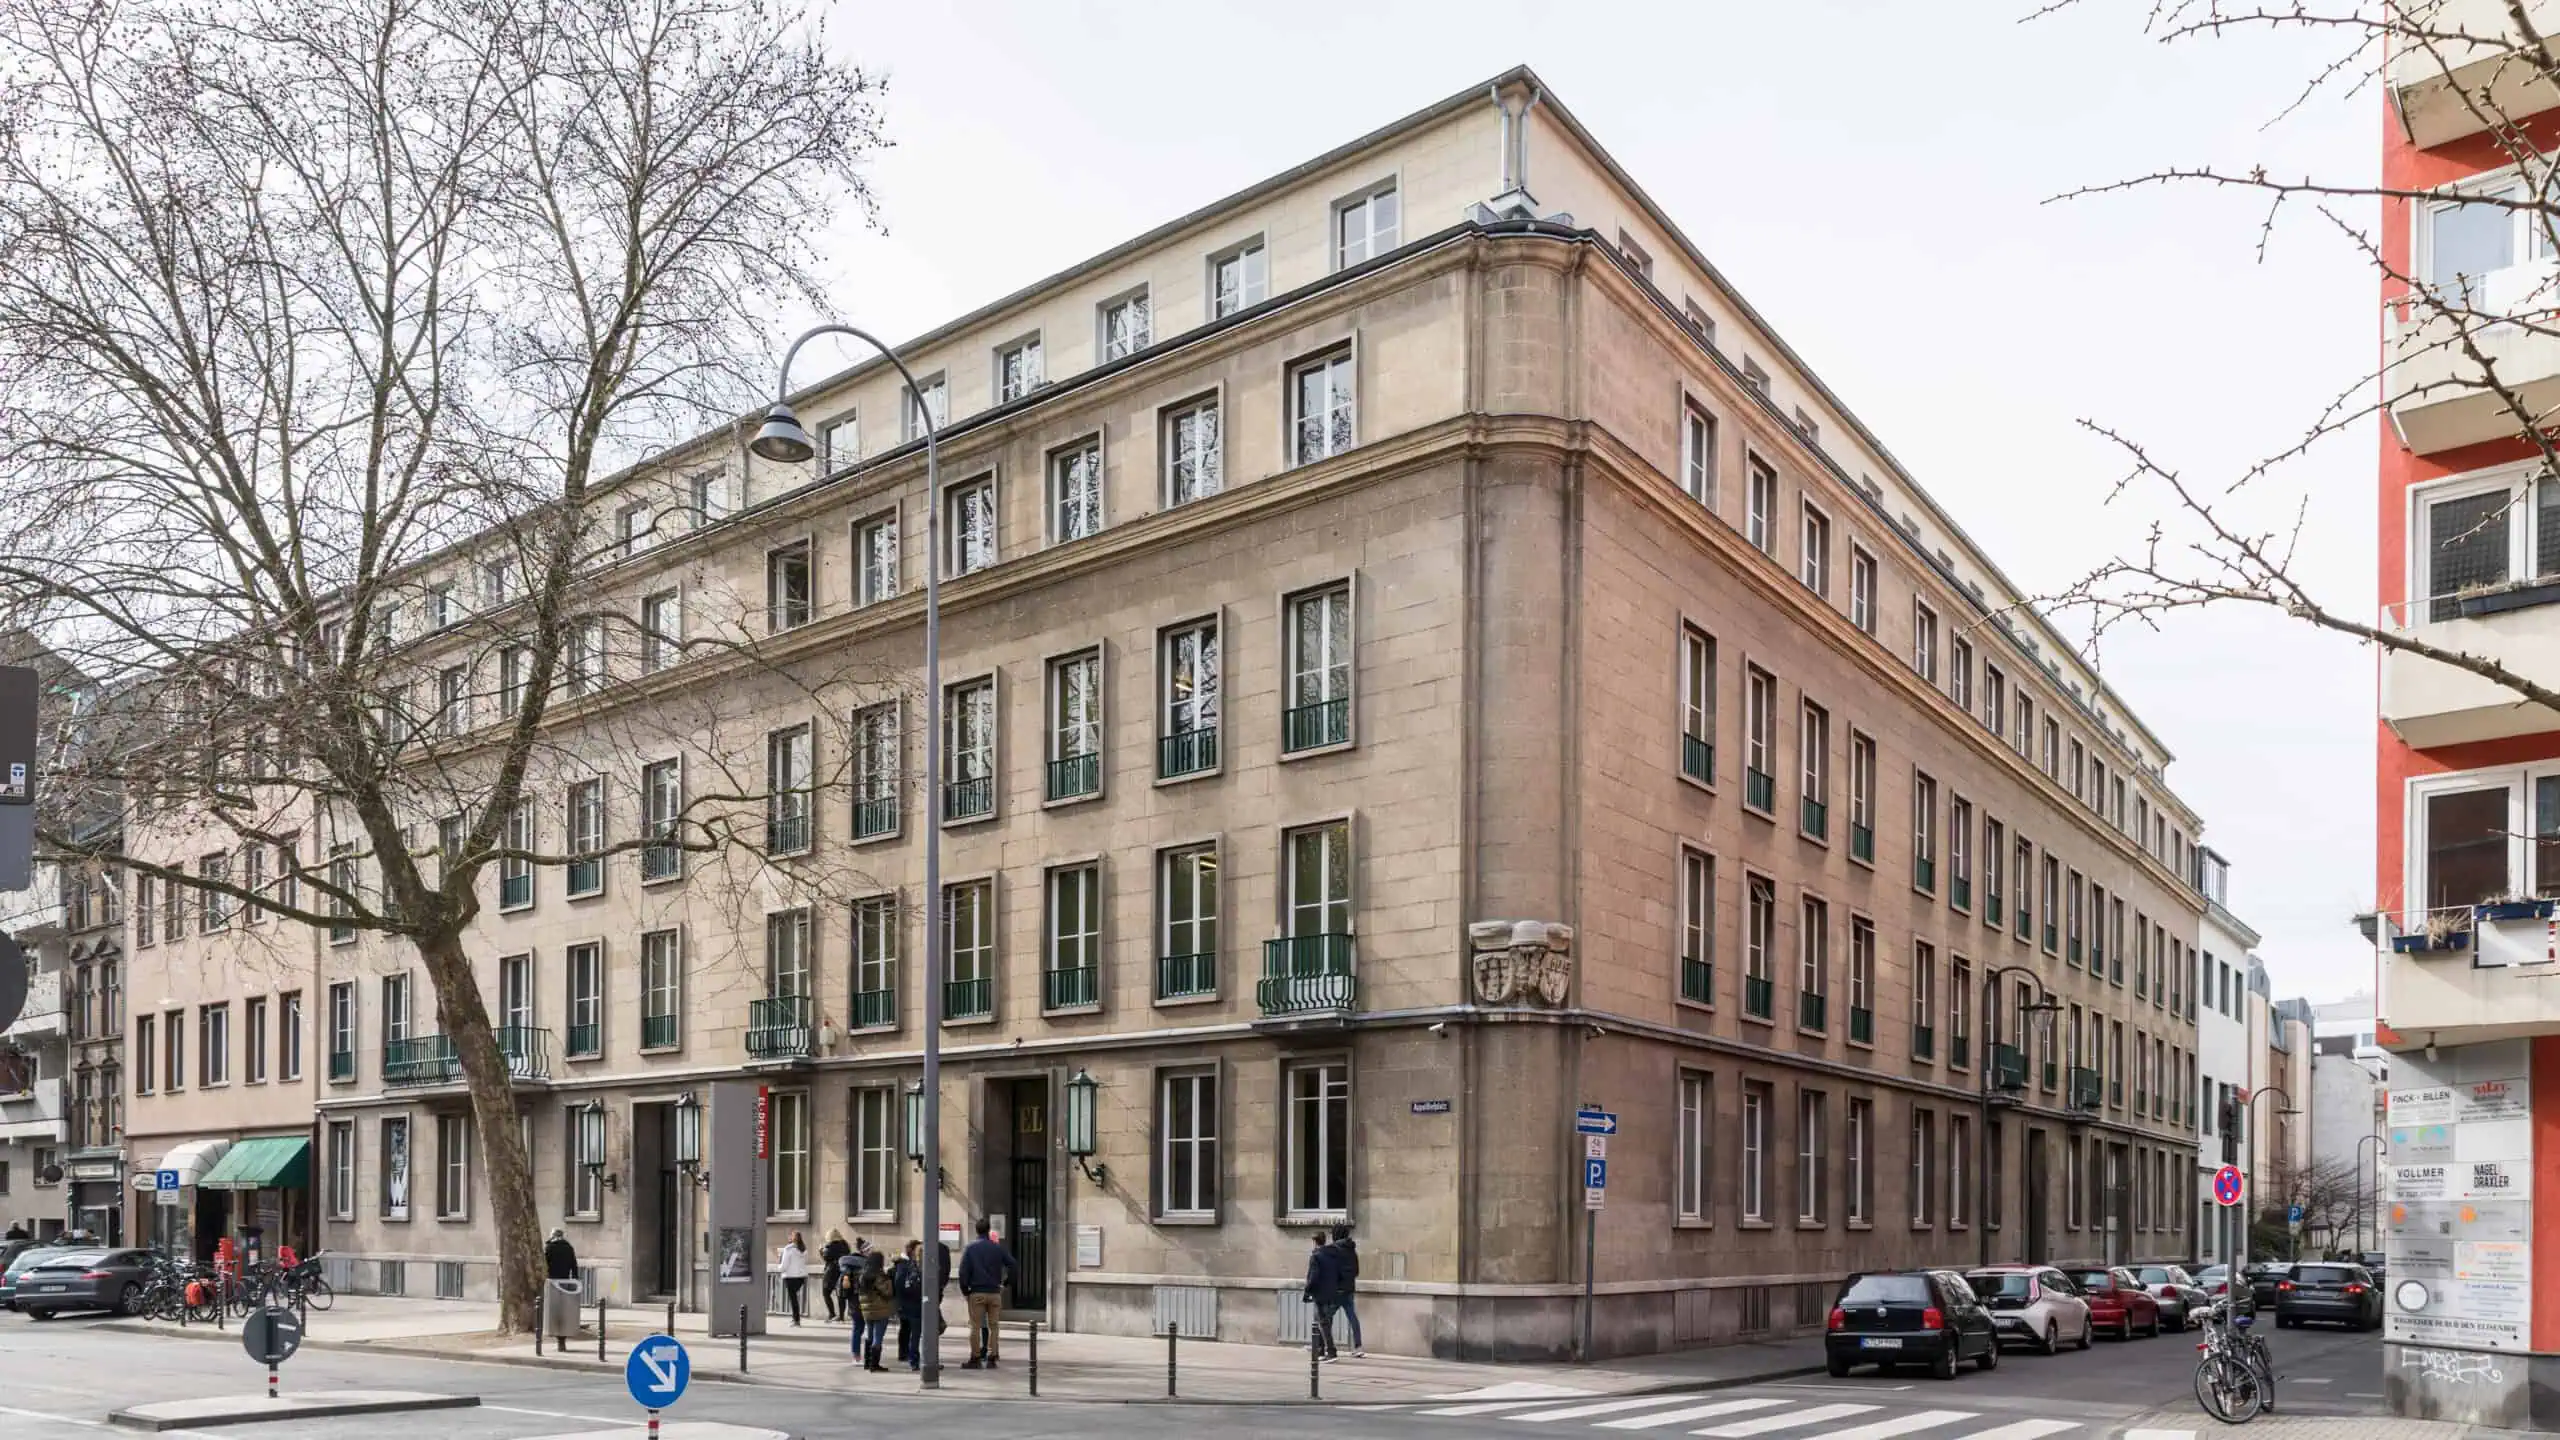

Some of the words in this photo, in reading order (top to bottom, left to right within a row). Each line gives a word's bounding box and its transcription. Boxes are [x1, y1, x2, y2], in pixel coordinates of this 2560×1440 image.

[2396, 1168, 2444, 1178] VOLLMER
[2473, 1164, 2498, 1176] NAGEL
[162, 1173, 174, 1189] P
[2473, 1176, 2509, 1188] DRAXLER
